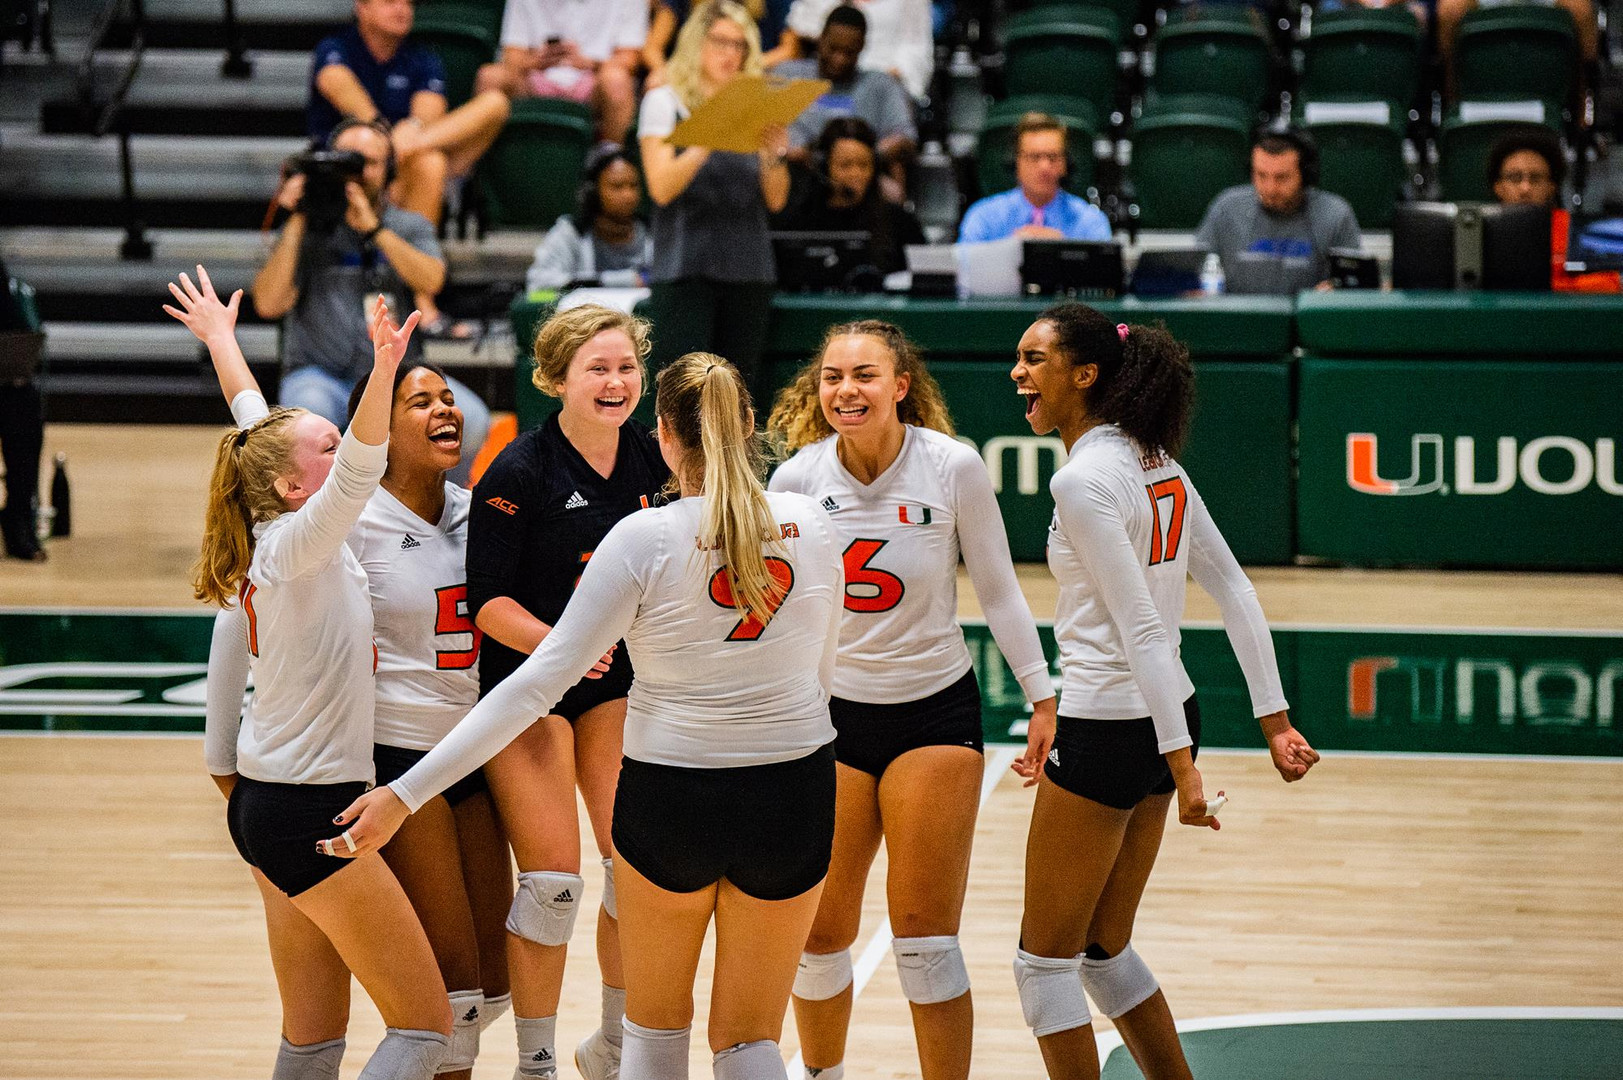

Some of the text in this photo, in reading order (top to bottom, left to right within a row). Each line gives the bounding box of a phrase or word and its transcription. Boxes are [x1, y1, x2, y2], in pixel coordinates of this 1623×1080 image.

[401, 541, 421, 549] adidas
[485, 496, 520, 515] ACC
[1145, 475, 1187, 567] 17
[708, 555, 795, 643] 9
[841, 537, 906, 613] 6
[434, 583, 482, 670] 5
